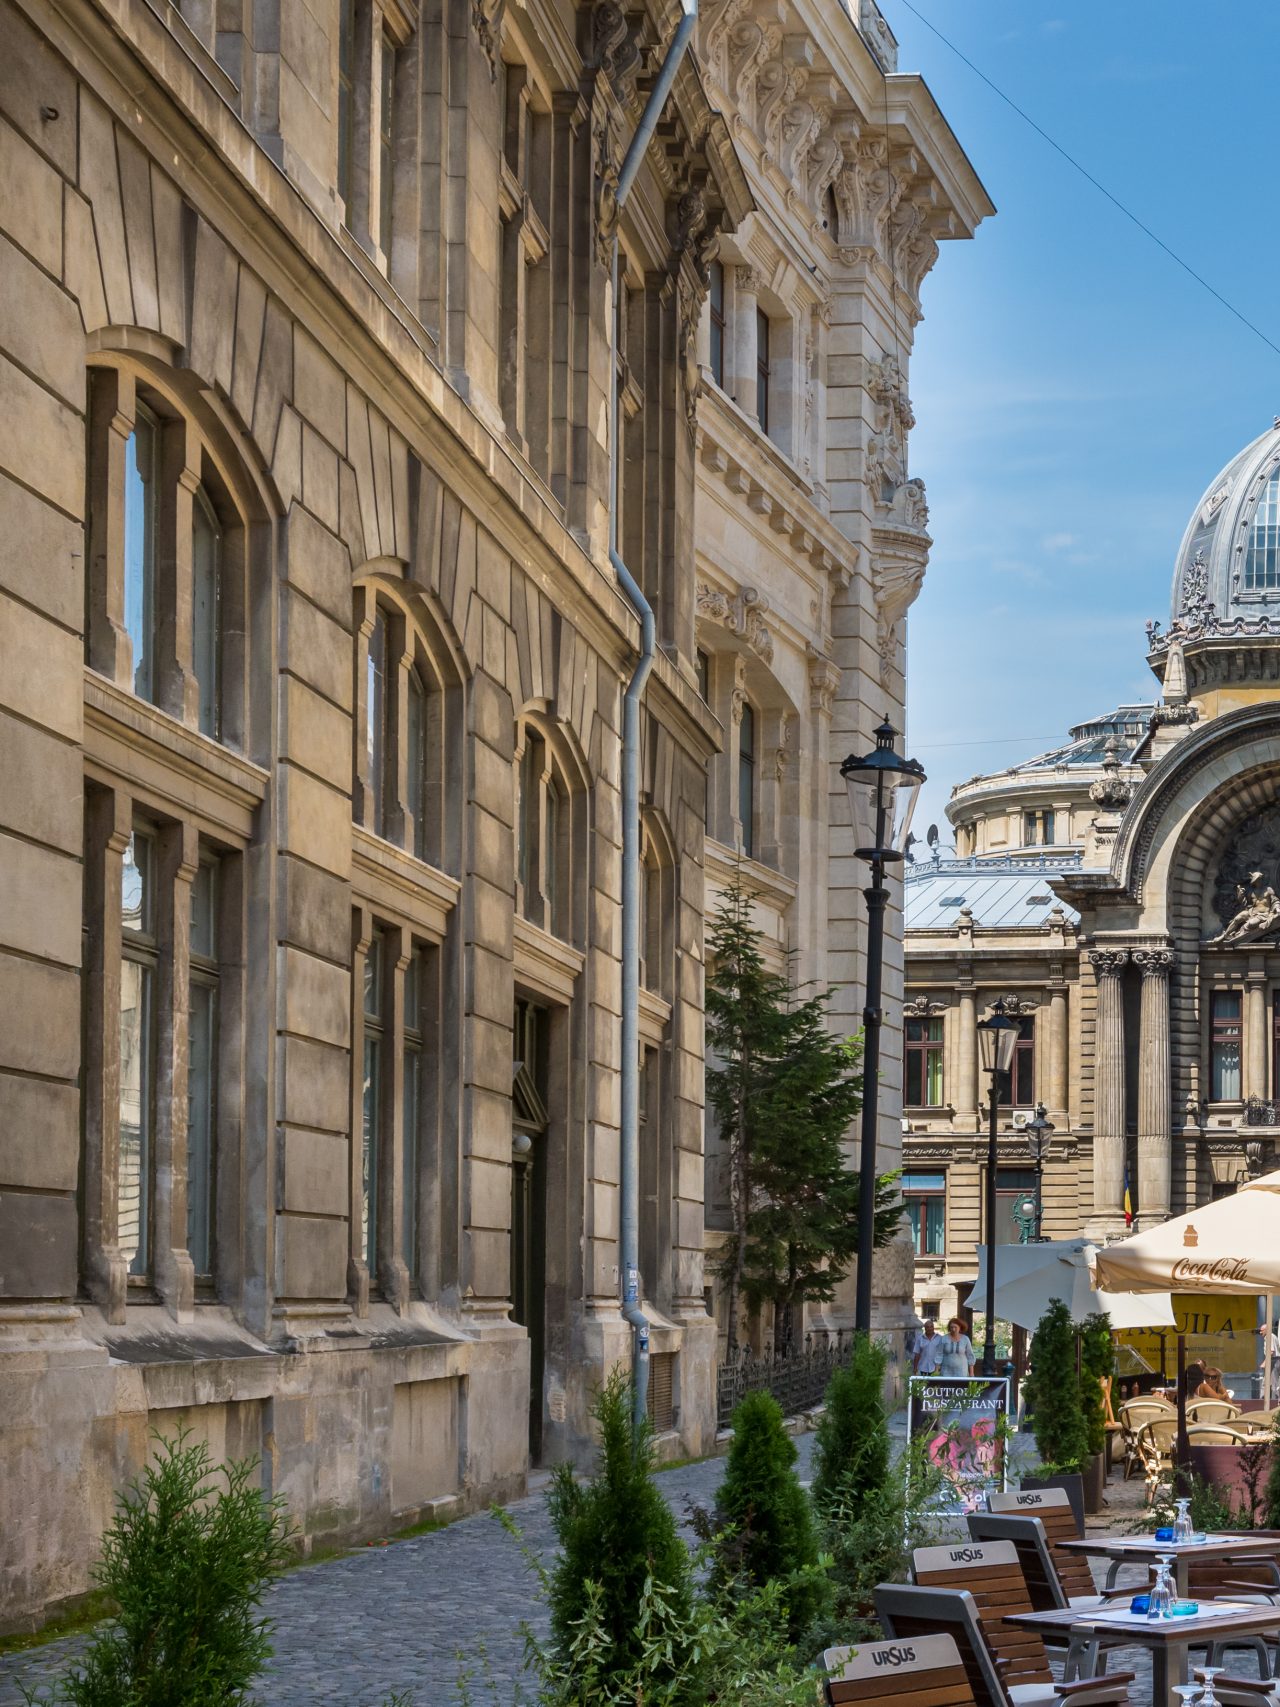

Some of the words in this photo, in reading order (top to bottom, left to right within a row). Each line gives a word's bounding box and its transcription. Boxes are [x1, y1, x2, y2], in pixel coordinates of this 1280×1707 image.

[1171, 1257, 1252, 1282] Coca-Cola
[1016, 1494, 1042, 1505] URSUS
[949, 1548, 983, 1562] URSUS
[871, 1646, 916, 1666] URSUS
